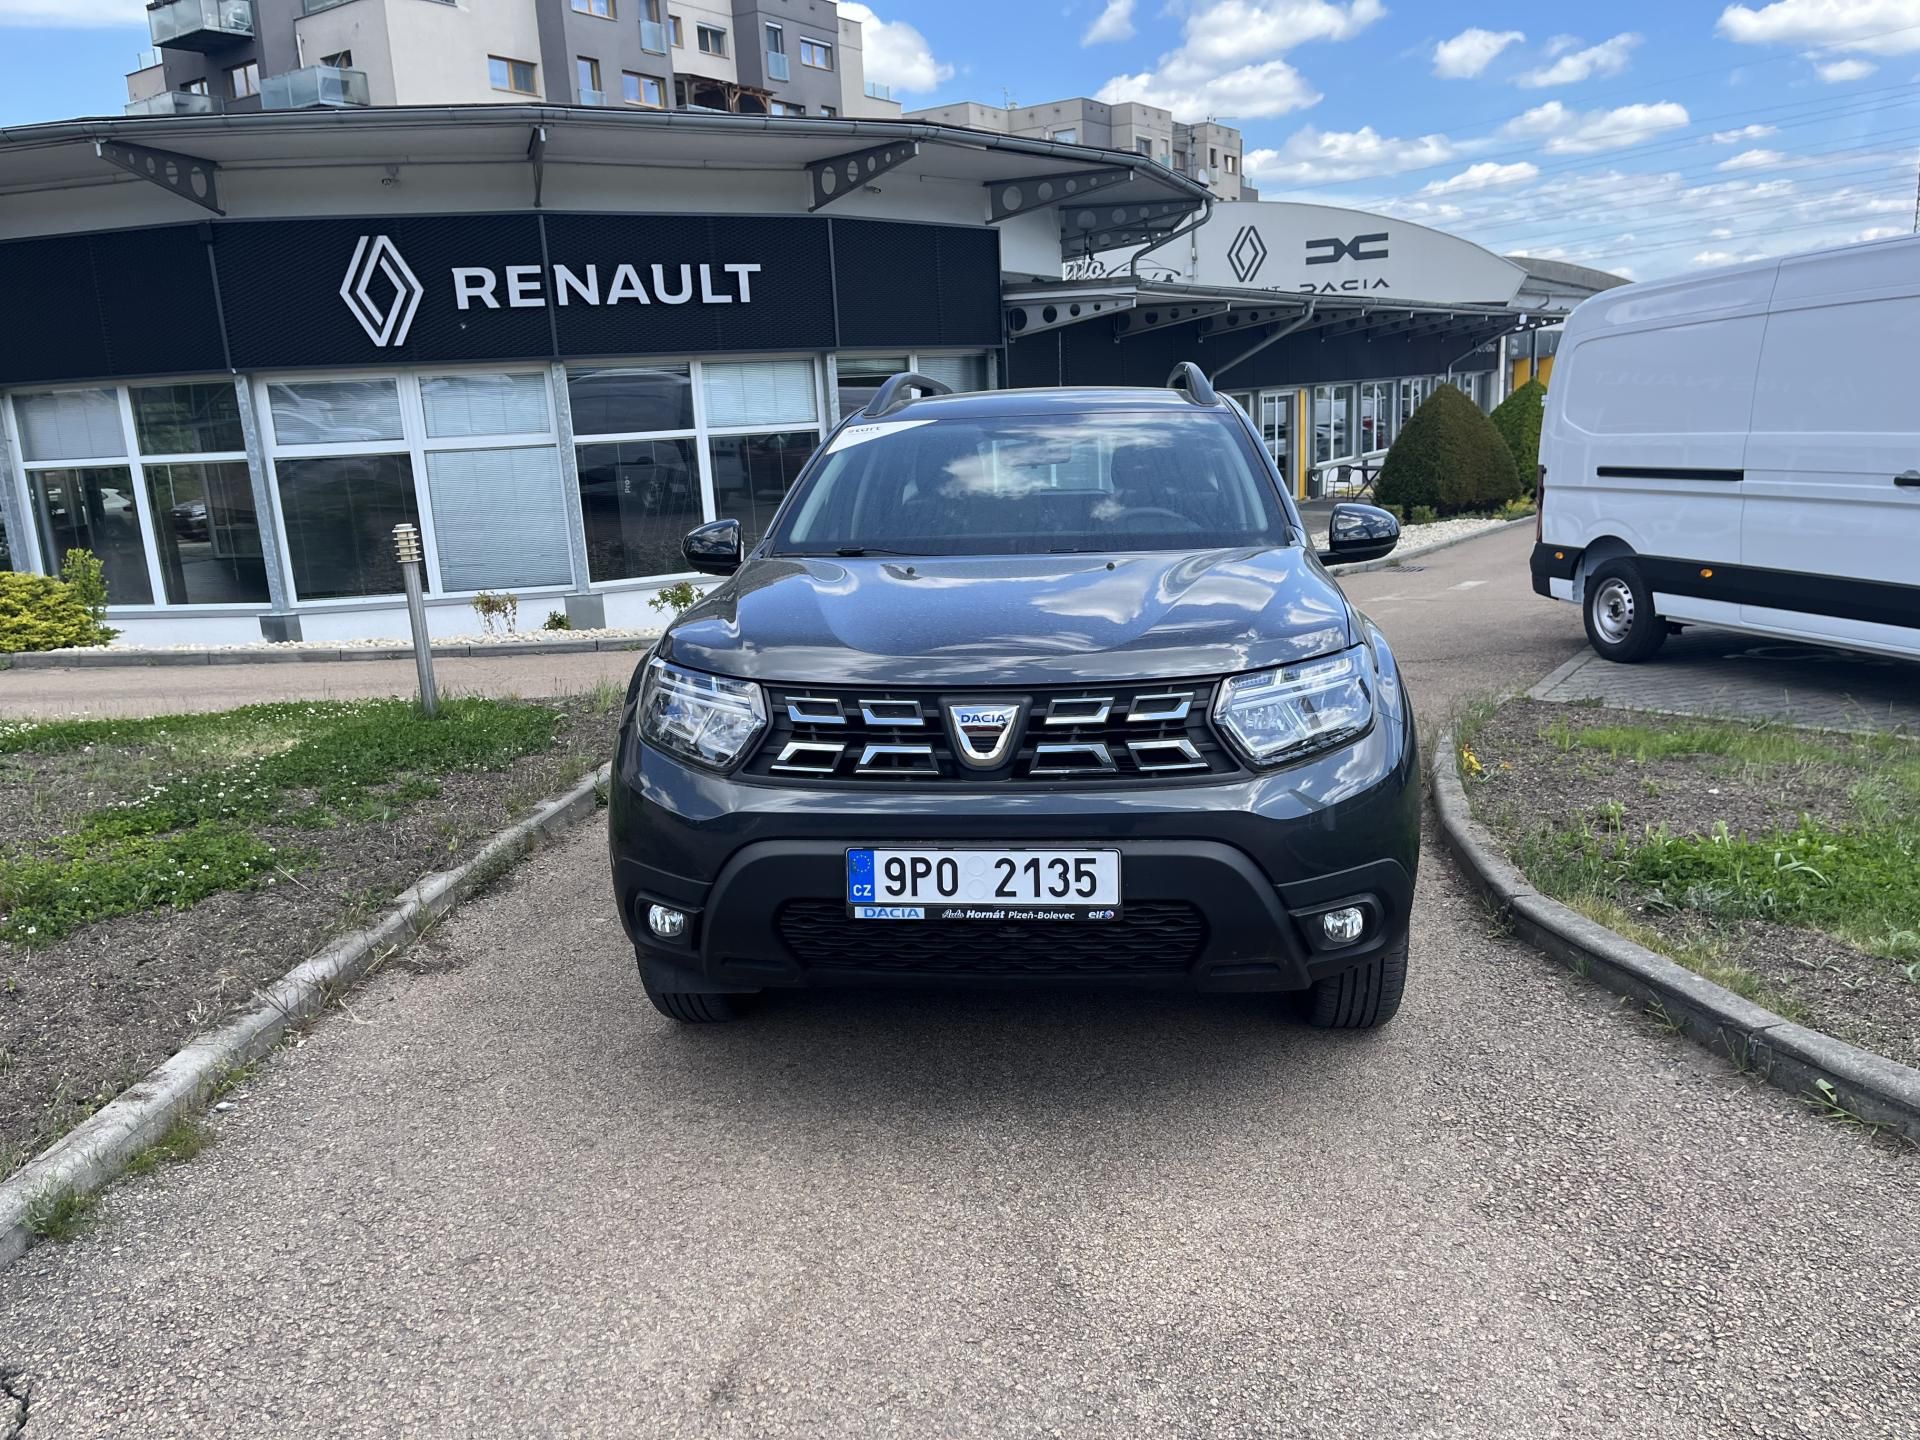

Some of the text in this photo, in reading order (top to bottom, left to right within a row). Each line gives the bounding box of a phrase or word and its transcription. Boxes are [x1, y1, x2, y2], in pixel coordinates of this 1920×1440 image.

[451, 263, 761, 310] RENAULT
[1299, 277, 1390, 294] DACIA
[961, 714, 1006, 723] DACIA
[884, 857, 1097, 898] 9P0 2135
[853, 884, 872, 897] CZ
[863, 908, 920, 919] DACIA
[941, 908, 1076, 921] Auto Hornát Plzeň-Bolevec
[1088, 910, 1106, 919] elf
